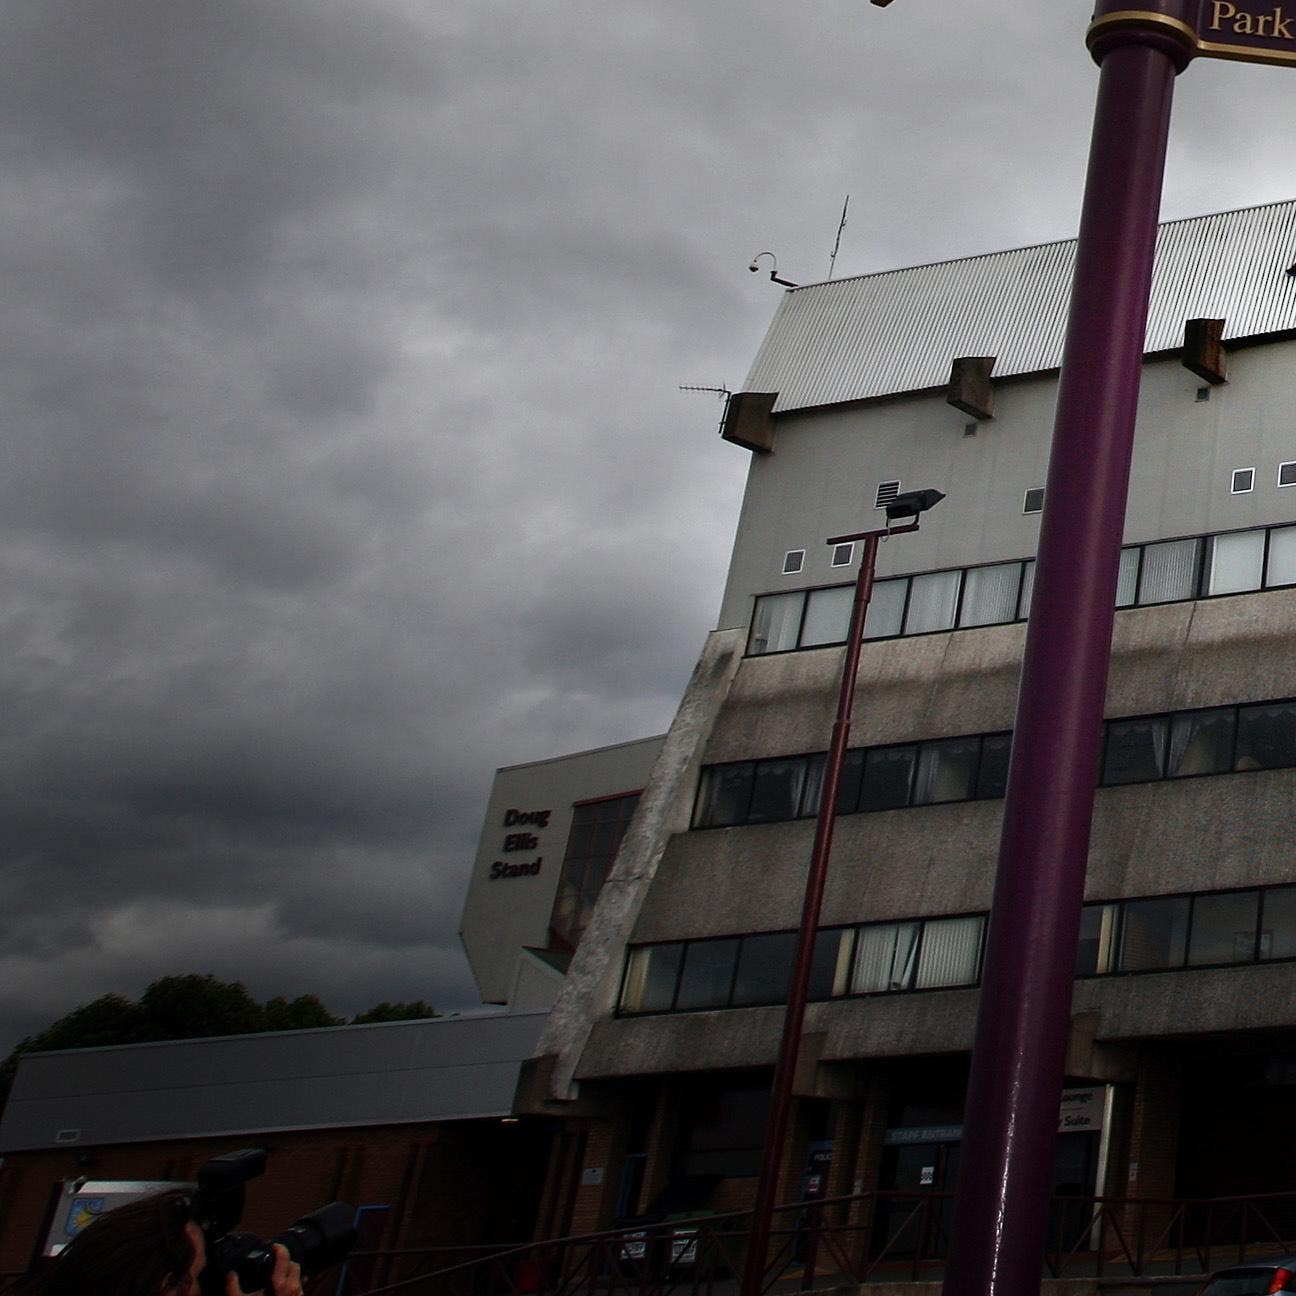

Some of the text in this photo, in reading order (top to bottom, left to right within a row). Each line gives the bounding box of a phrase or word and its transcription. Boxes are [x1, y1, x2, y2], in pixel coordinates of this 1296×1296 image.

[1208, 1, 1295, 41] Park
[504, 808, 552, 828] Doug
[502, 833, 539, 853] Ellis
[490, 857, 542, 880] Stand
